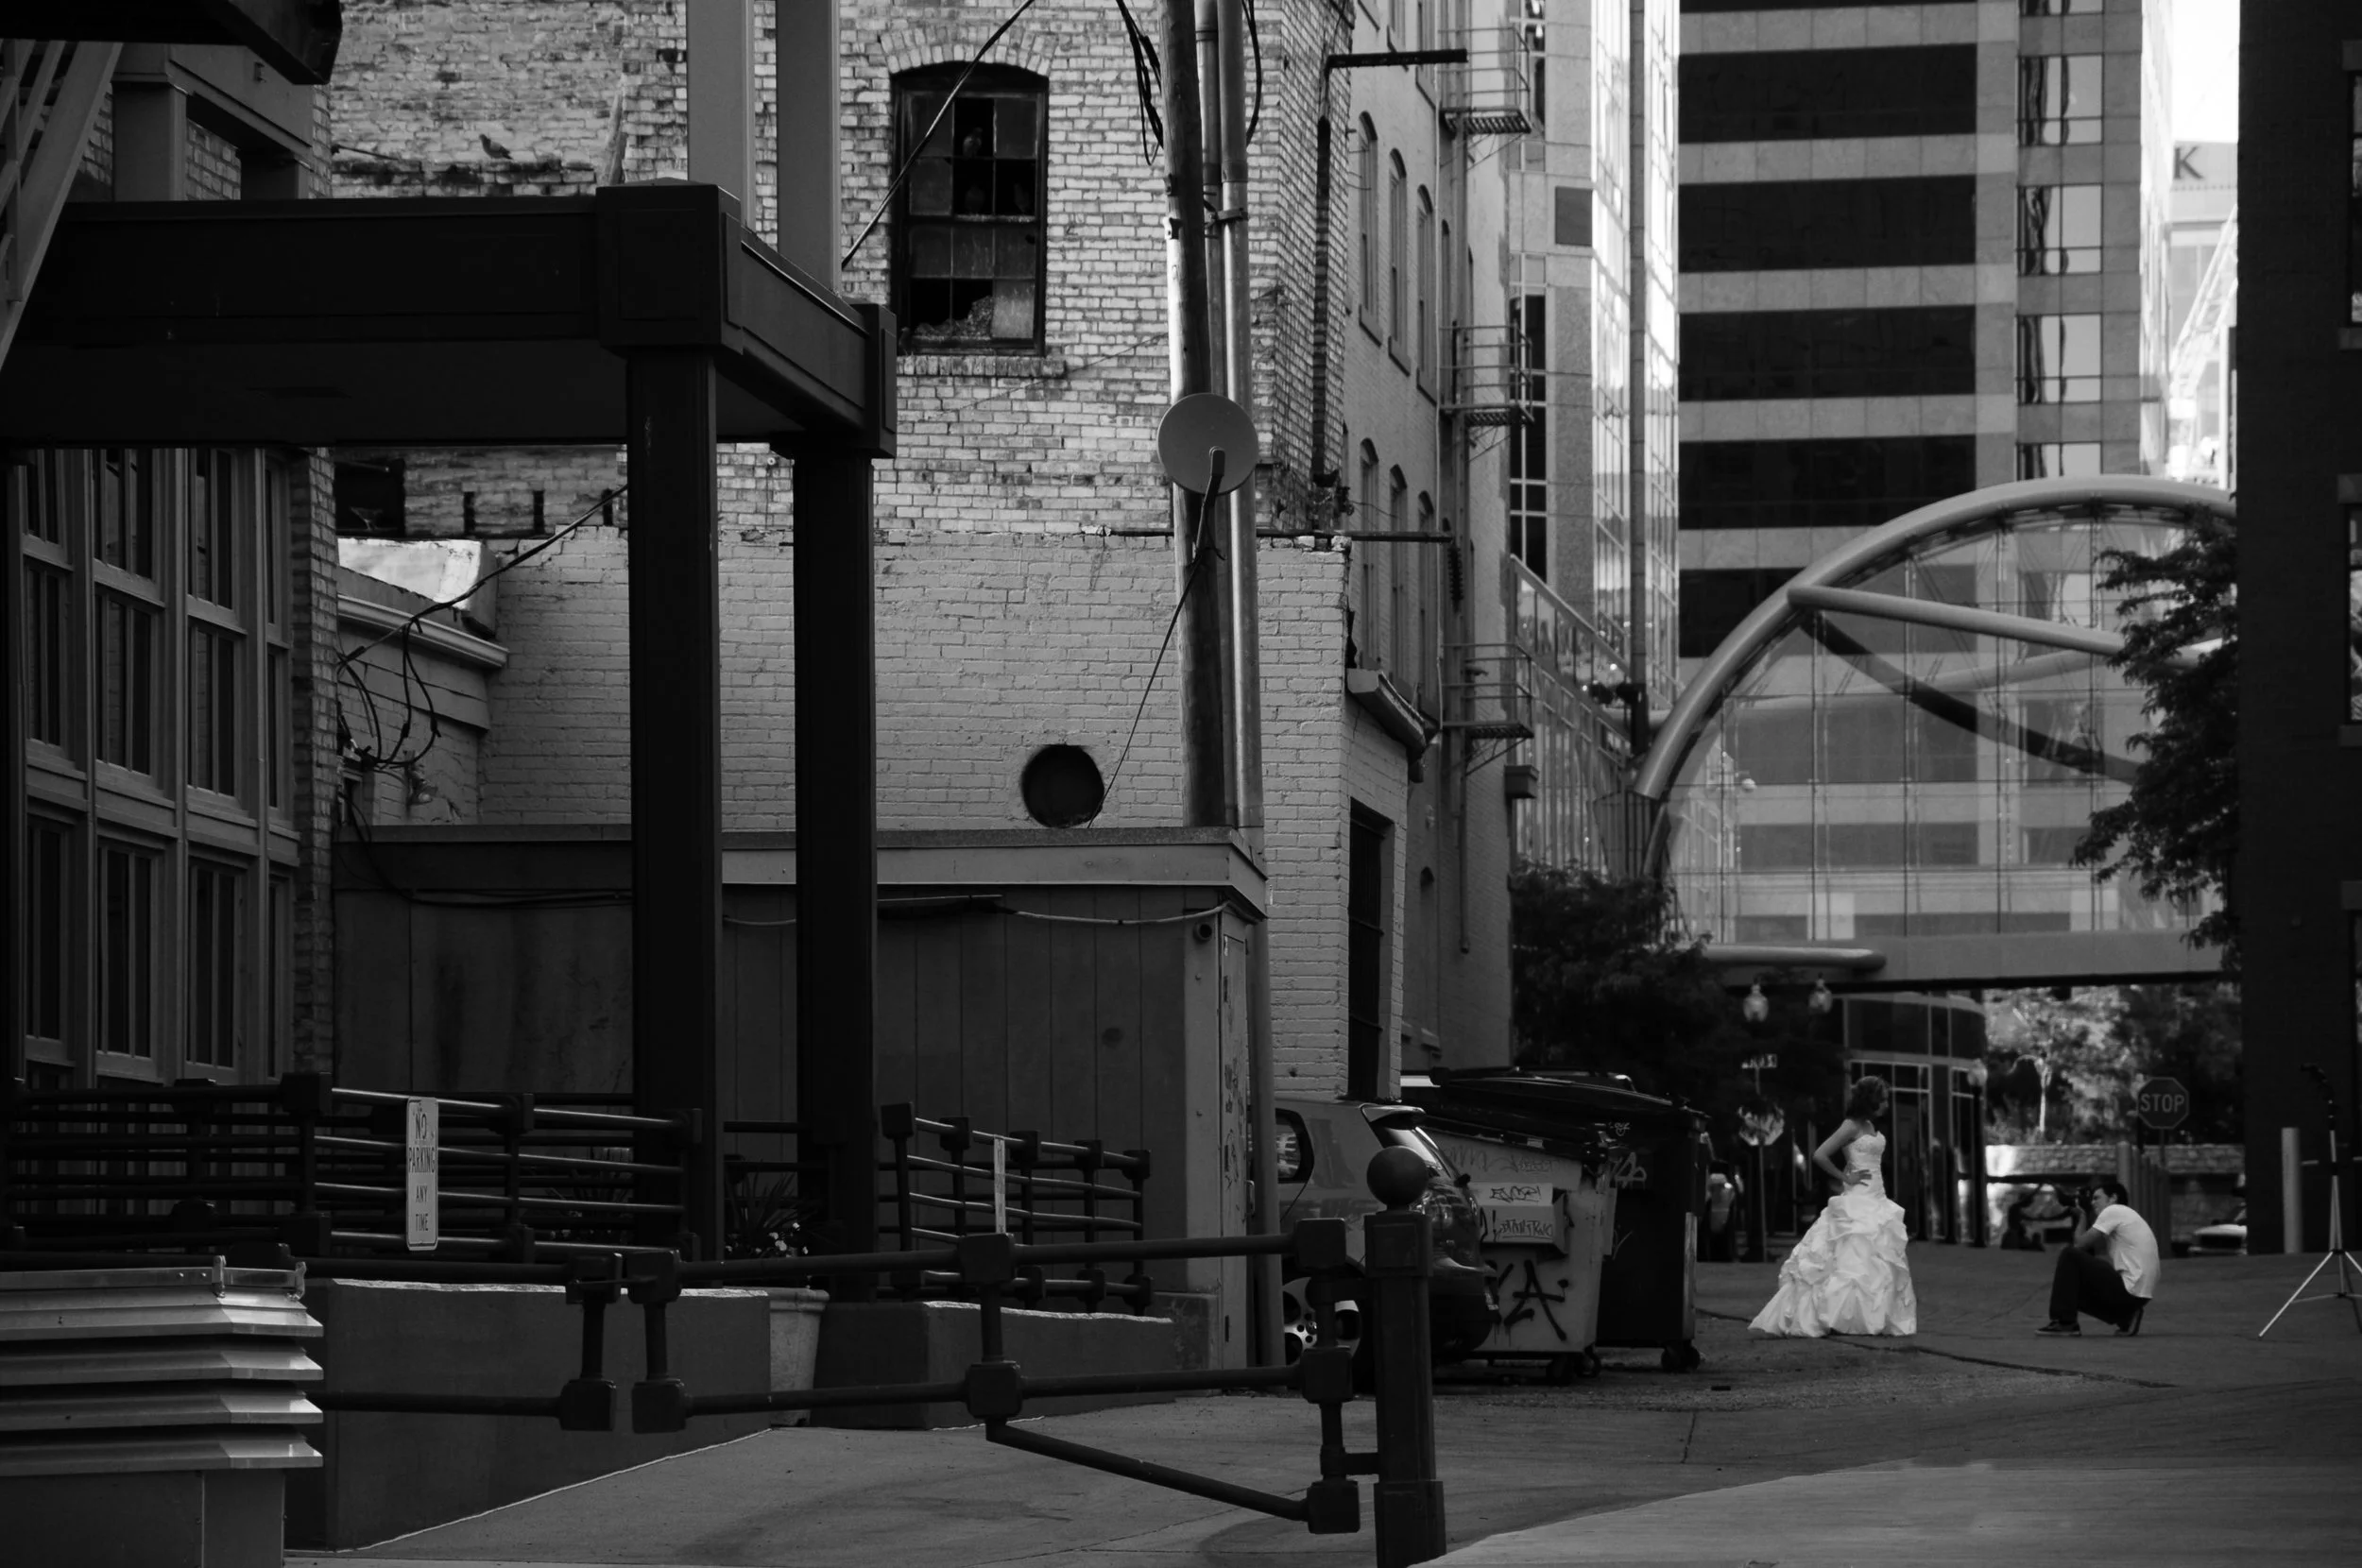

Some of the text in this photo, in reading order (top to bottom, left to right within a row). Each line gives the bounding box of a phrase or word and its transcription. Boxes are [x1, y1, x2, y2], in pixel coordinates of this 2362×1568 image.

[2140, 1093, 2185, 1114] STOP
[415, 1114, 428, 1140] NO
[408, 1147, 436, 1173] PARKING
[415, 1185, 428, 1203] ANY
[415, 1213, 429, 1232] TIME
